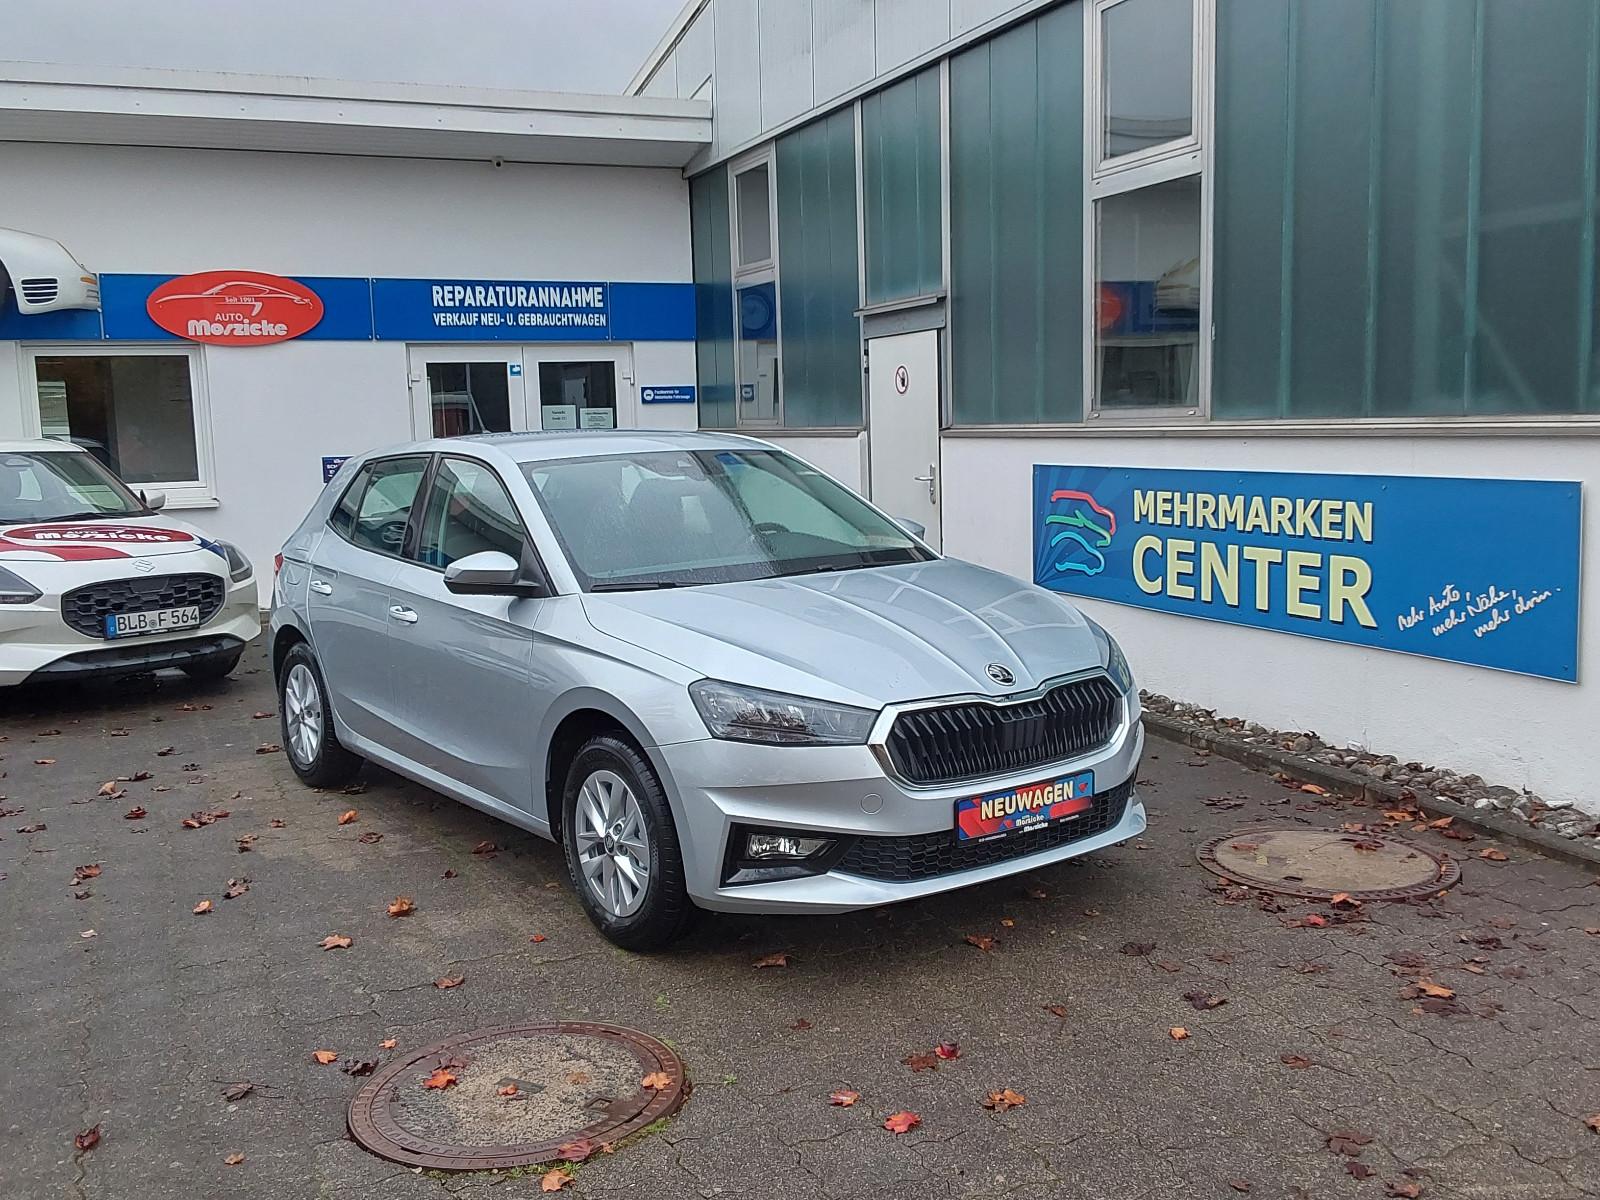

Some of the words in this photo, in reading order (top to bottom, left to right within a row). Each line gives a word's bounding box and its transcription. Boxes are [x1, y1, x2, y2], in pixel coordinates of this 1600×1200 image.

[432, 285, 603, 308] REPARATURANNAHME
[215, 313, 243, 322] AUTO
[433, 312, 479, 327] VERKAUF
[480, 312, 505, 327] NEU-
[506, 313, 516, 327] U.
[518, 313, 606, 328] GEBRAUCHTWAGEN
[1133, 489, 1373, 542] MEHRMARKEN
[1132, 535, 1378, 628] CENTER
[117, 613, 148, 632] BLB
[158, 611, 168, 627] F
[171, 607, 198, 625] 564
[981, 780, 1074, 820] NEUWAGEN
